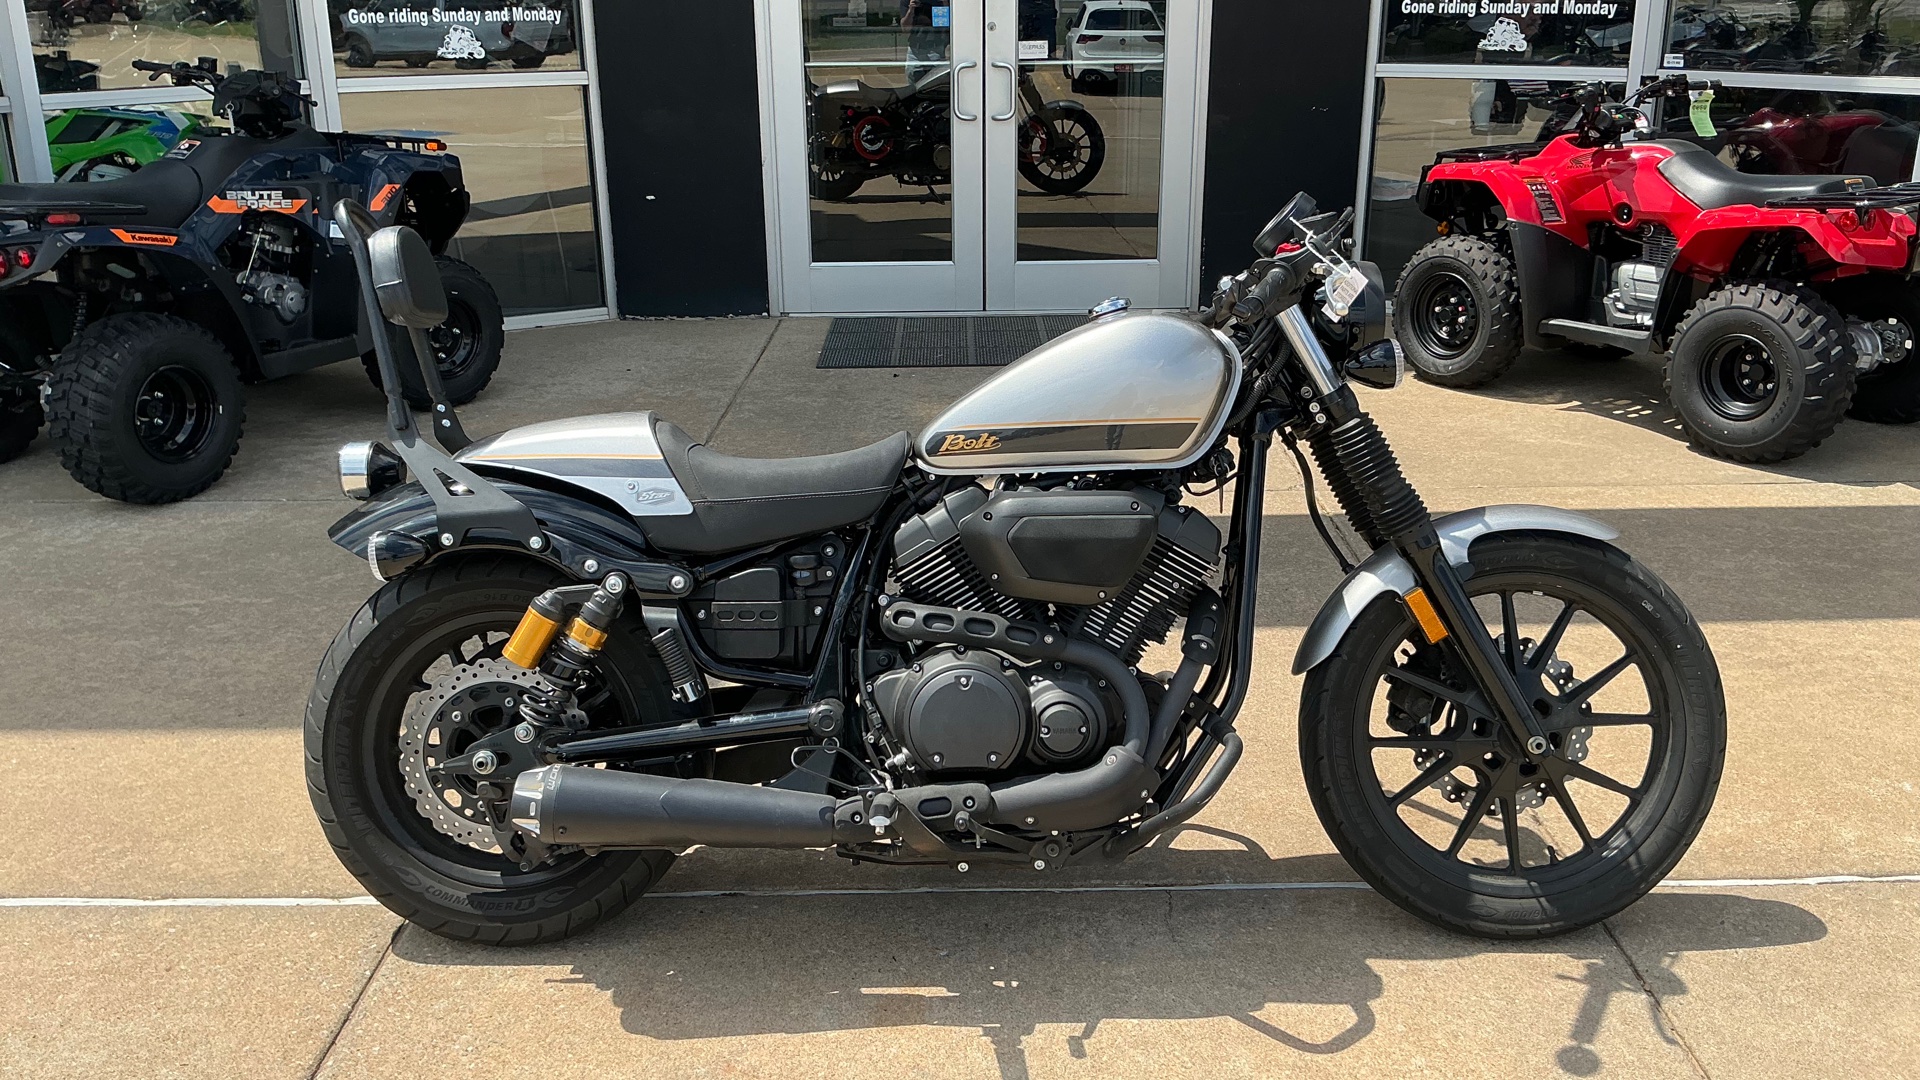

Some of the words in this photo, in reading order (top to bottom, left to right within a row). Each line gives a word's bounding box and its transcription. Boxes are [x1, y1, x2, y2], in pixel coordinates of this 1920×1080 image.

[349, 9, 385, 24] Gone
[388, 8, 429, 26] riding
[432, 7, 481, 25] Sunday
[484, 7, 510, 22] and
[512, 7, 562, 25] Monday
[1401, 0, 1435, 14] Gone
[1438, 0, 1477, 17] riding
[1480, 0, 1529, 17] Sunday
[1533, 0, 1559, 15] and
[1563, 1, 1618, 18] Monday
[226, 190, 283, 201] BRUTE
[236, 199, 293, 209] FORCE
[380, 185, 398, 206] 300
[130, 233, 173, 246] Kawasaki
[938, 433, 1001, 454] Bolt
[638, 490, 671, 502] Star
[425, 884, 512, 911] COMMANDER
